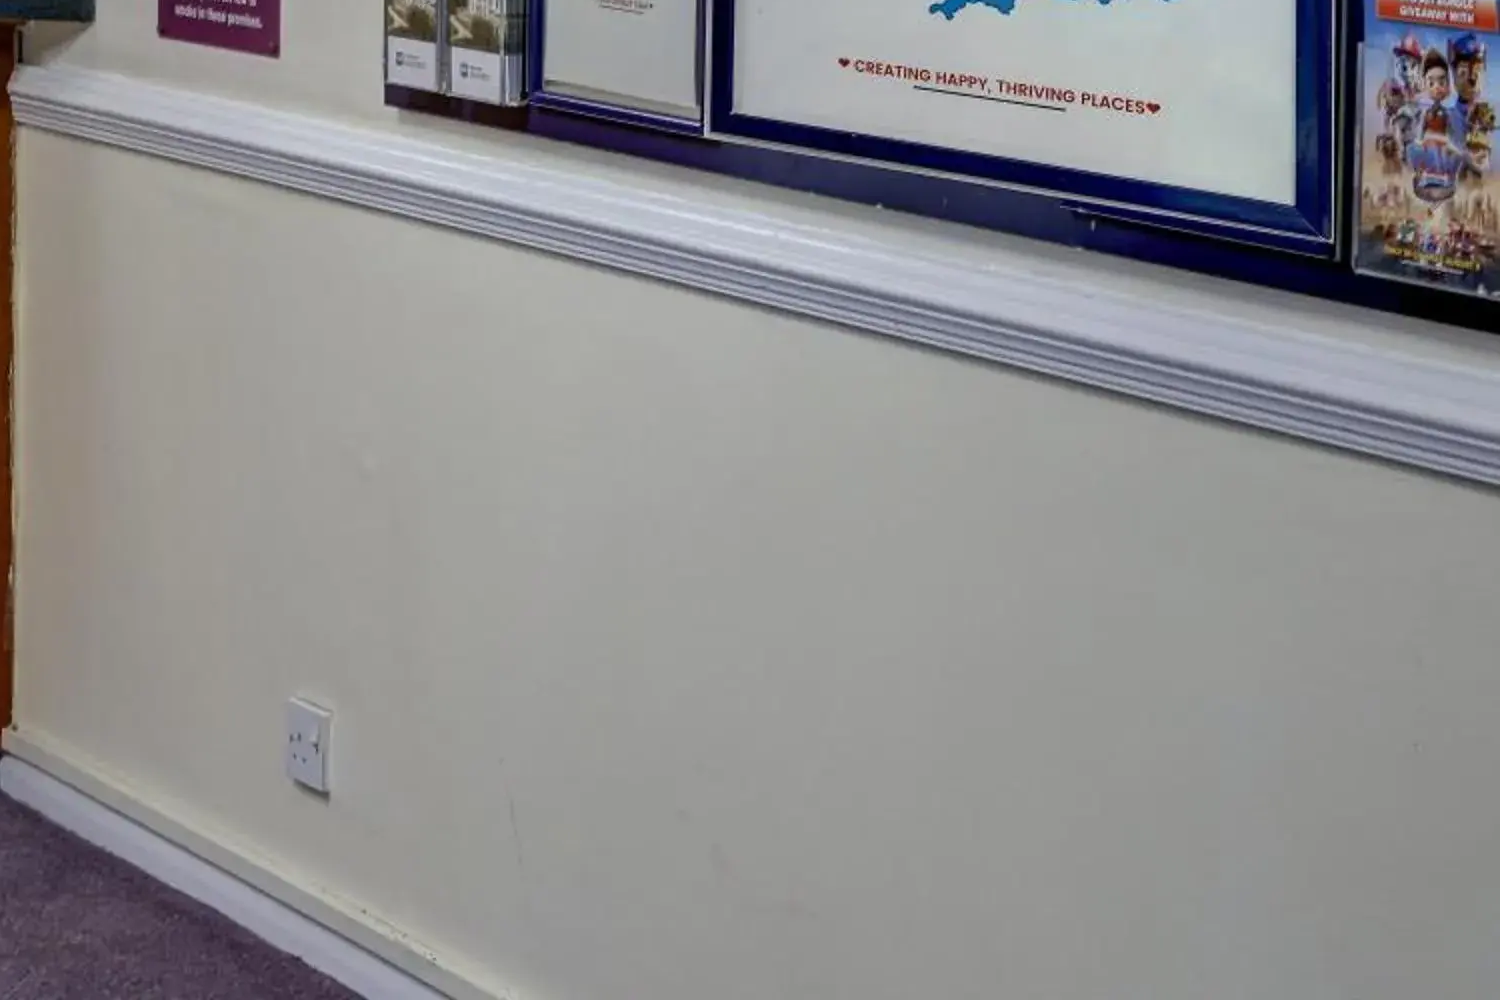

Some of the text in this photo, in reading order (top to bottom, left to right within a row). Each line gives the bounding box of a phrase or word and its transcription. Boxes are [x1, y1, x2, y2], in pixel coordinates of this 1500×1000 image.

[1399, 5, 1476, 25] GIVEAWAY WITH
[853, 58, 1146, 115] CREATING HAPPY, THRIVING PLACES
